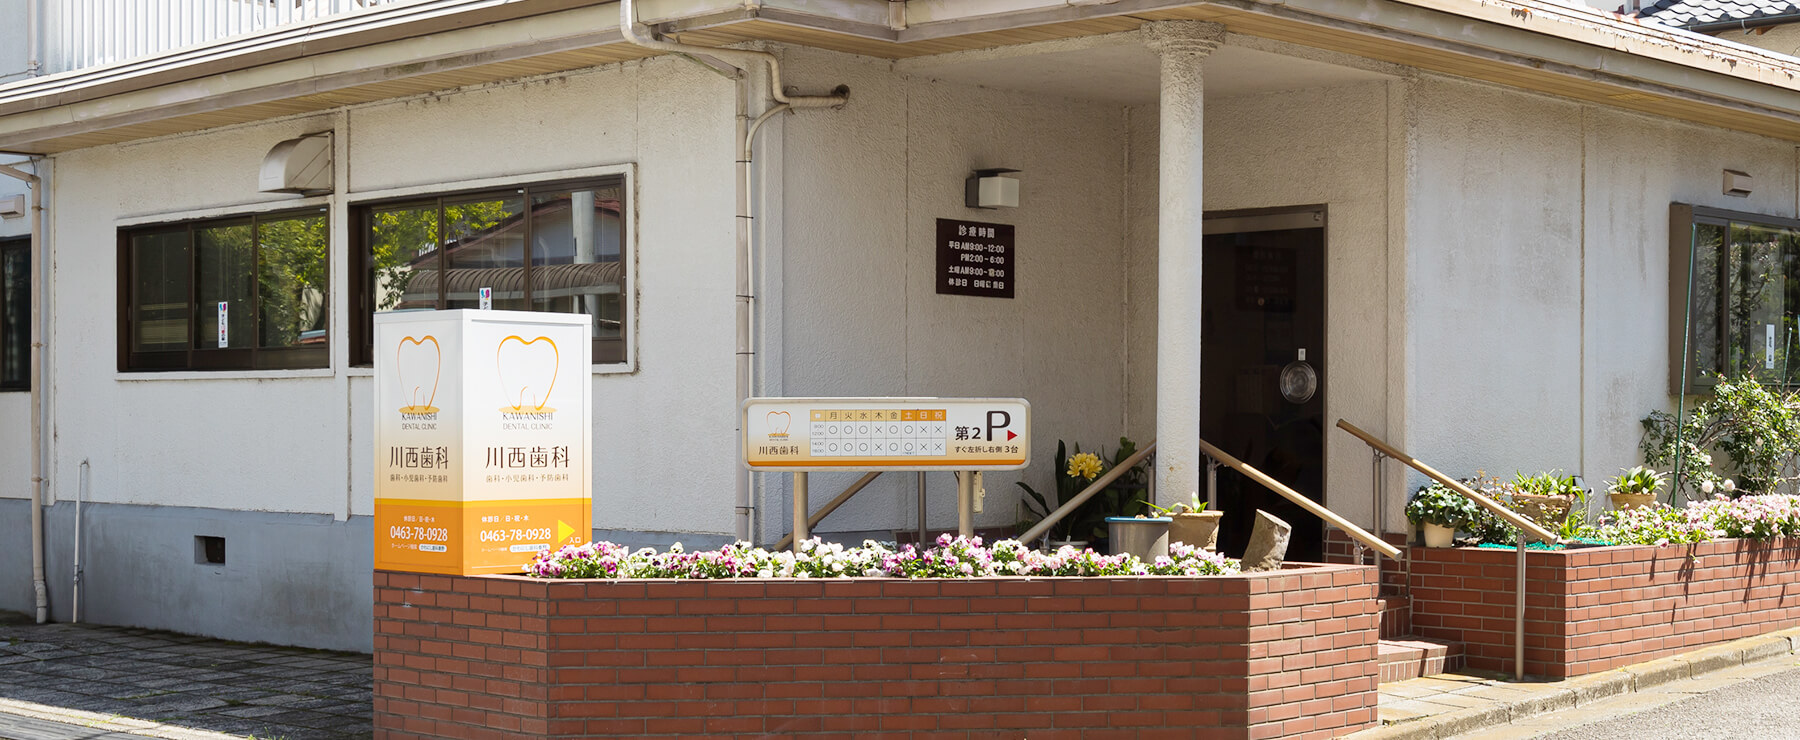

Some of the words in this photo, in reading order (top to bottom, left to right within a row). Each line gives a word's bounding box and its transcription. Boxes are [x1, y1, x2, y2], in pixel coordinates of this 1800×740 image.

[958, 224, 995, 239] 診療時間
[401, 412, 437, 421] KAWANISHI
[502, 412, 553, 421] KAWANISHI
[829, 411, 838, 420] 月
[844, 411, 853, 420] 火
[859, 411, 868, 420] 水
[875, 411, 883, 420] 木
[890, 411, 898, 420] 金
[904, 411, 913, 420] 土
[920, 411, 928, 420] 日
[934, 411, 943, 420] 祝
[401, 422, 420, 430] DENTAL
[421, 423, 437, 431] CLINIC
[986, 410, 1011, 442] P
[758, 445, 799, 456] 川西歯科
[954, 445, 1003, 454] すぐ左折し右側
[1004, 445, 1019, 454] 3台
[389, 446, 449, 470] 川西歯科
[485, 445, 571, 469] 川西歯科
[389, 525, 448, 542] 0463-78-0928
[479, 527, 552, 542] 0463-78-0928
[569, 536, 582, 544] 入口
